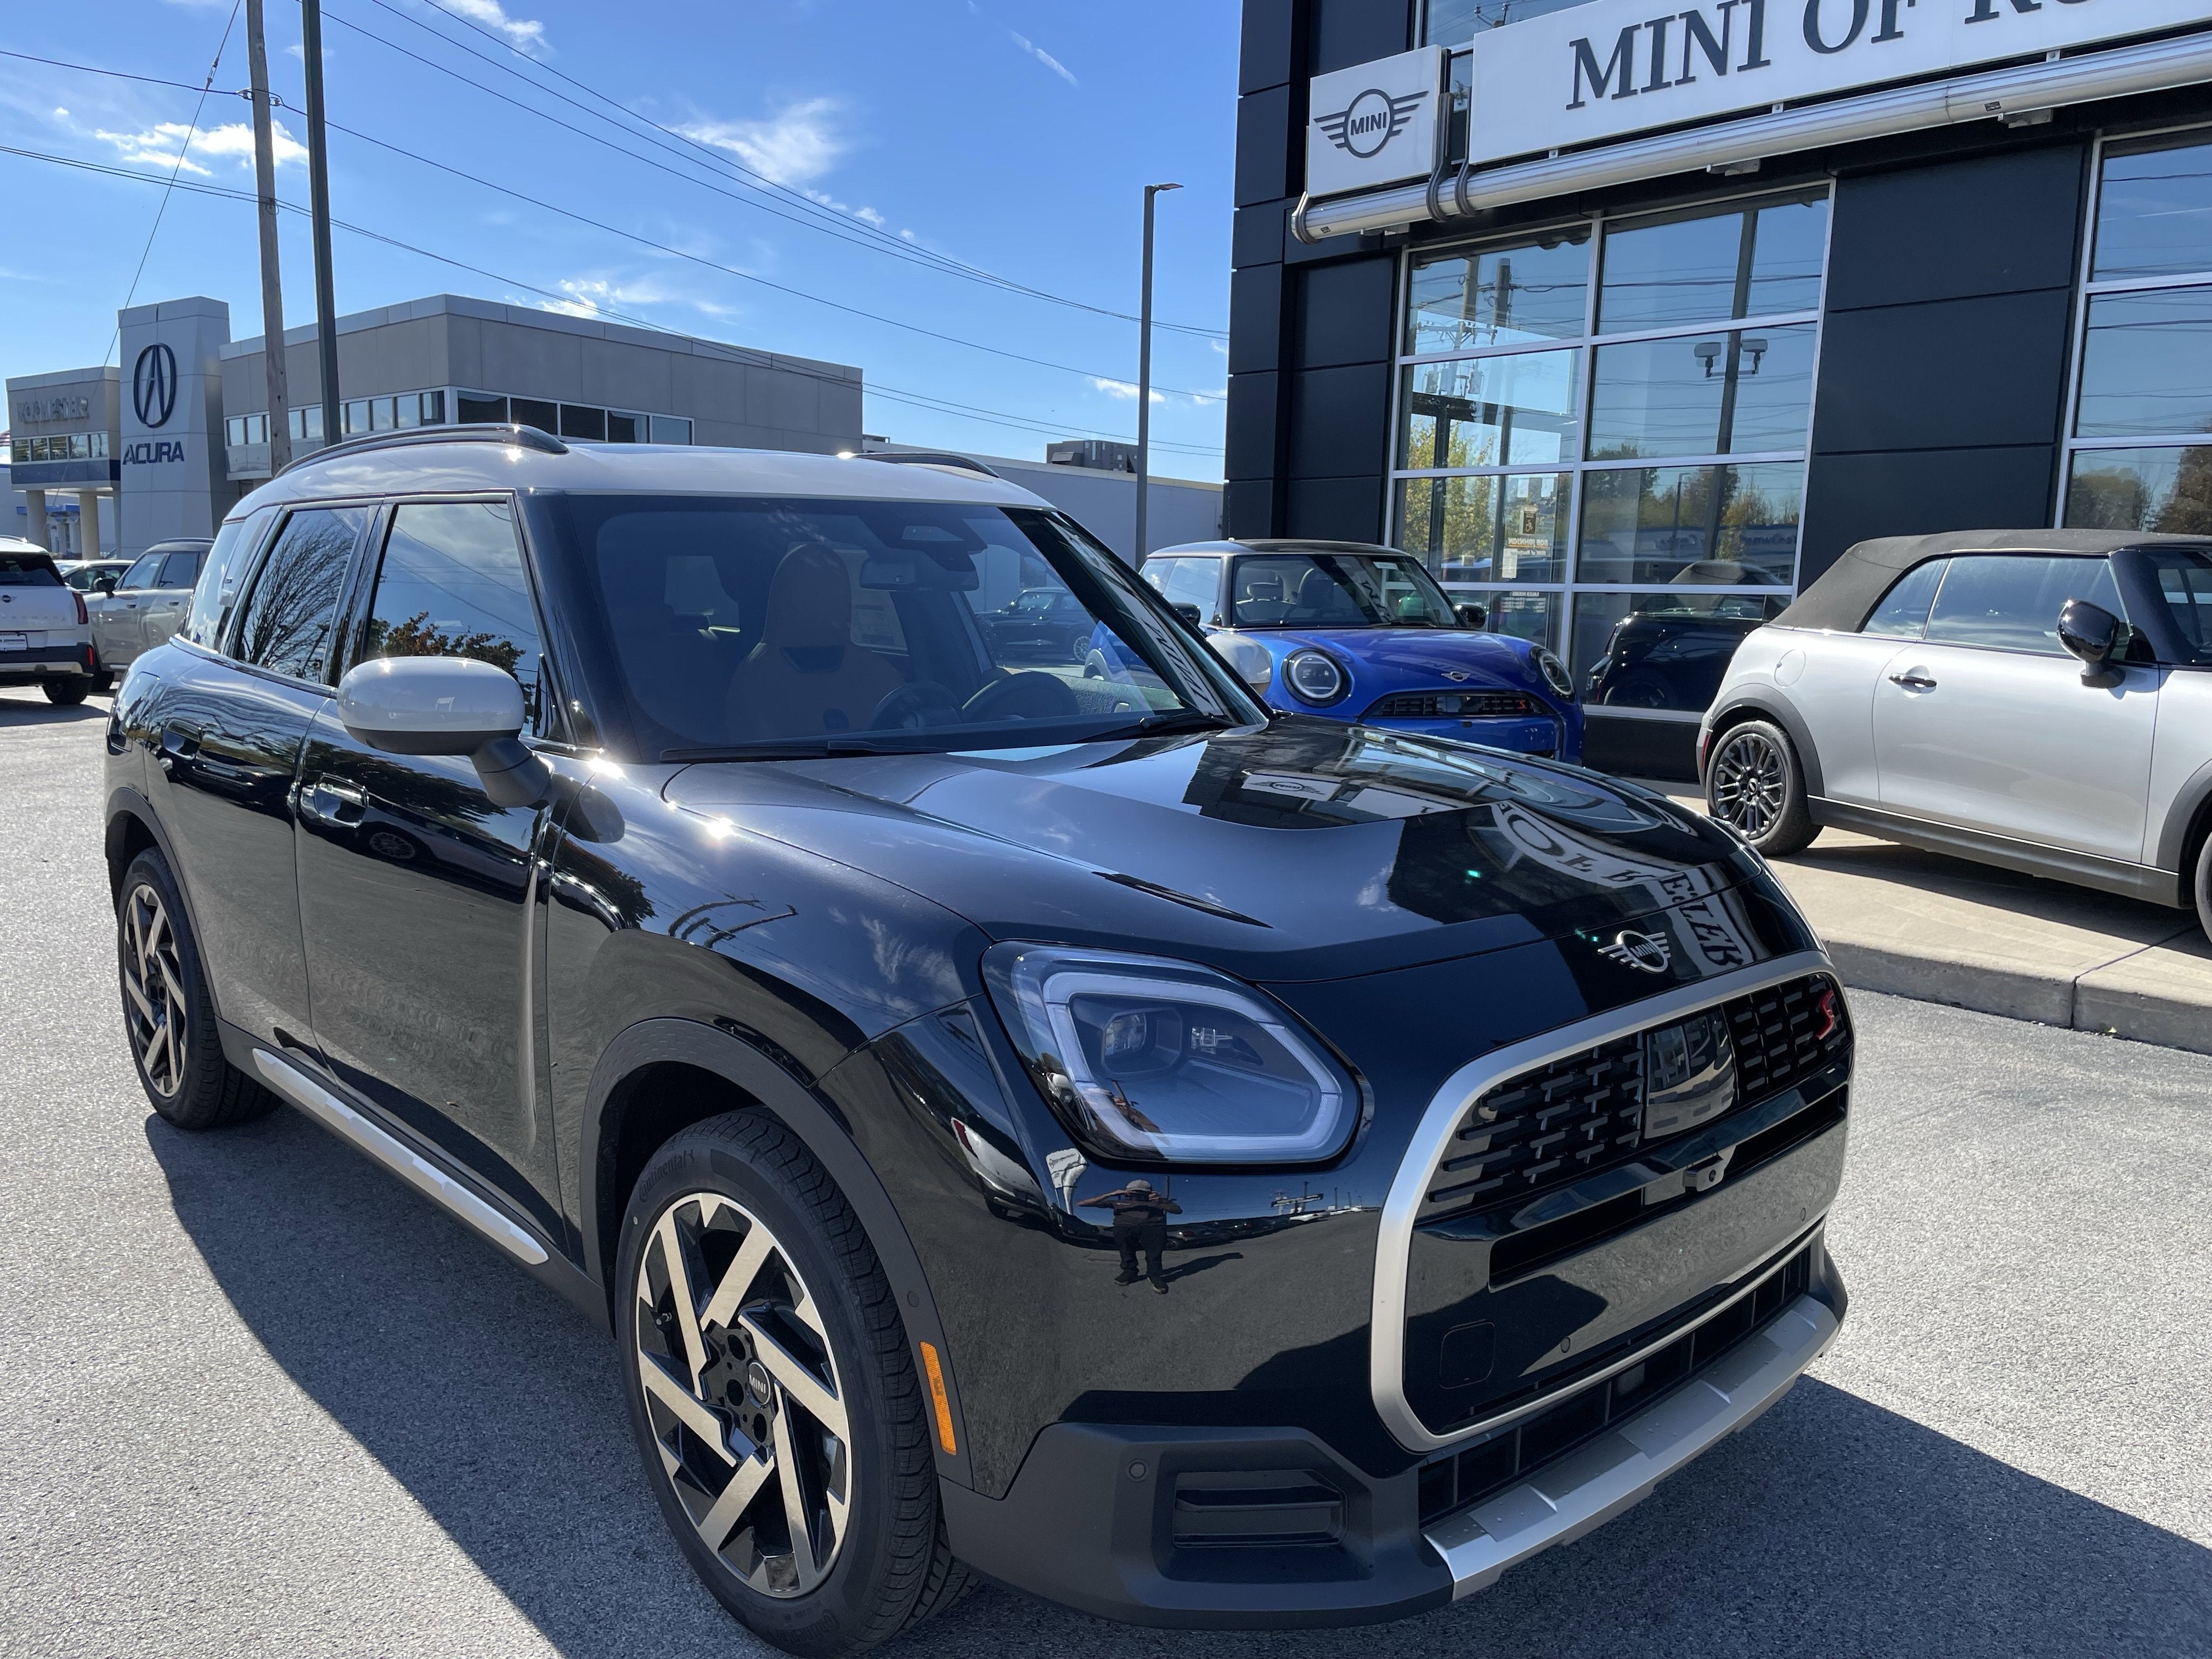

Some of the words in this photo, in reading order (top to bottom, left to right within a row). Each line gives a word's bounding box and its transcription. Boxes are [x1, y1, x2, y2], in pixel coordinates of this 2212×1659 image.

[1566, 0, 1770, 110] MINI
[1351, 111, 1387, 136] MINI
[122, 441, 184, 465] ACURA
[1629, 943, 1657, 958] MINI
[749, 1374, 766, 1394] MINI
